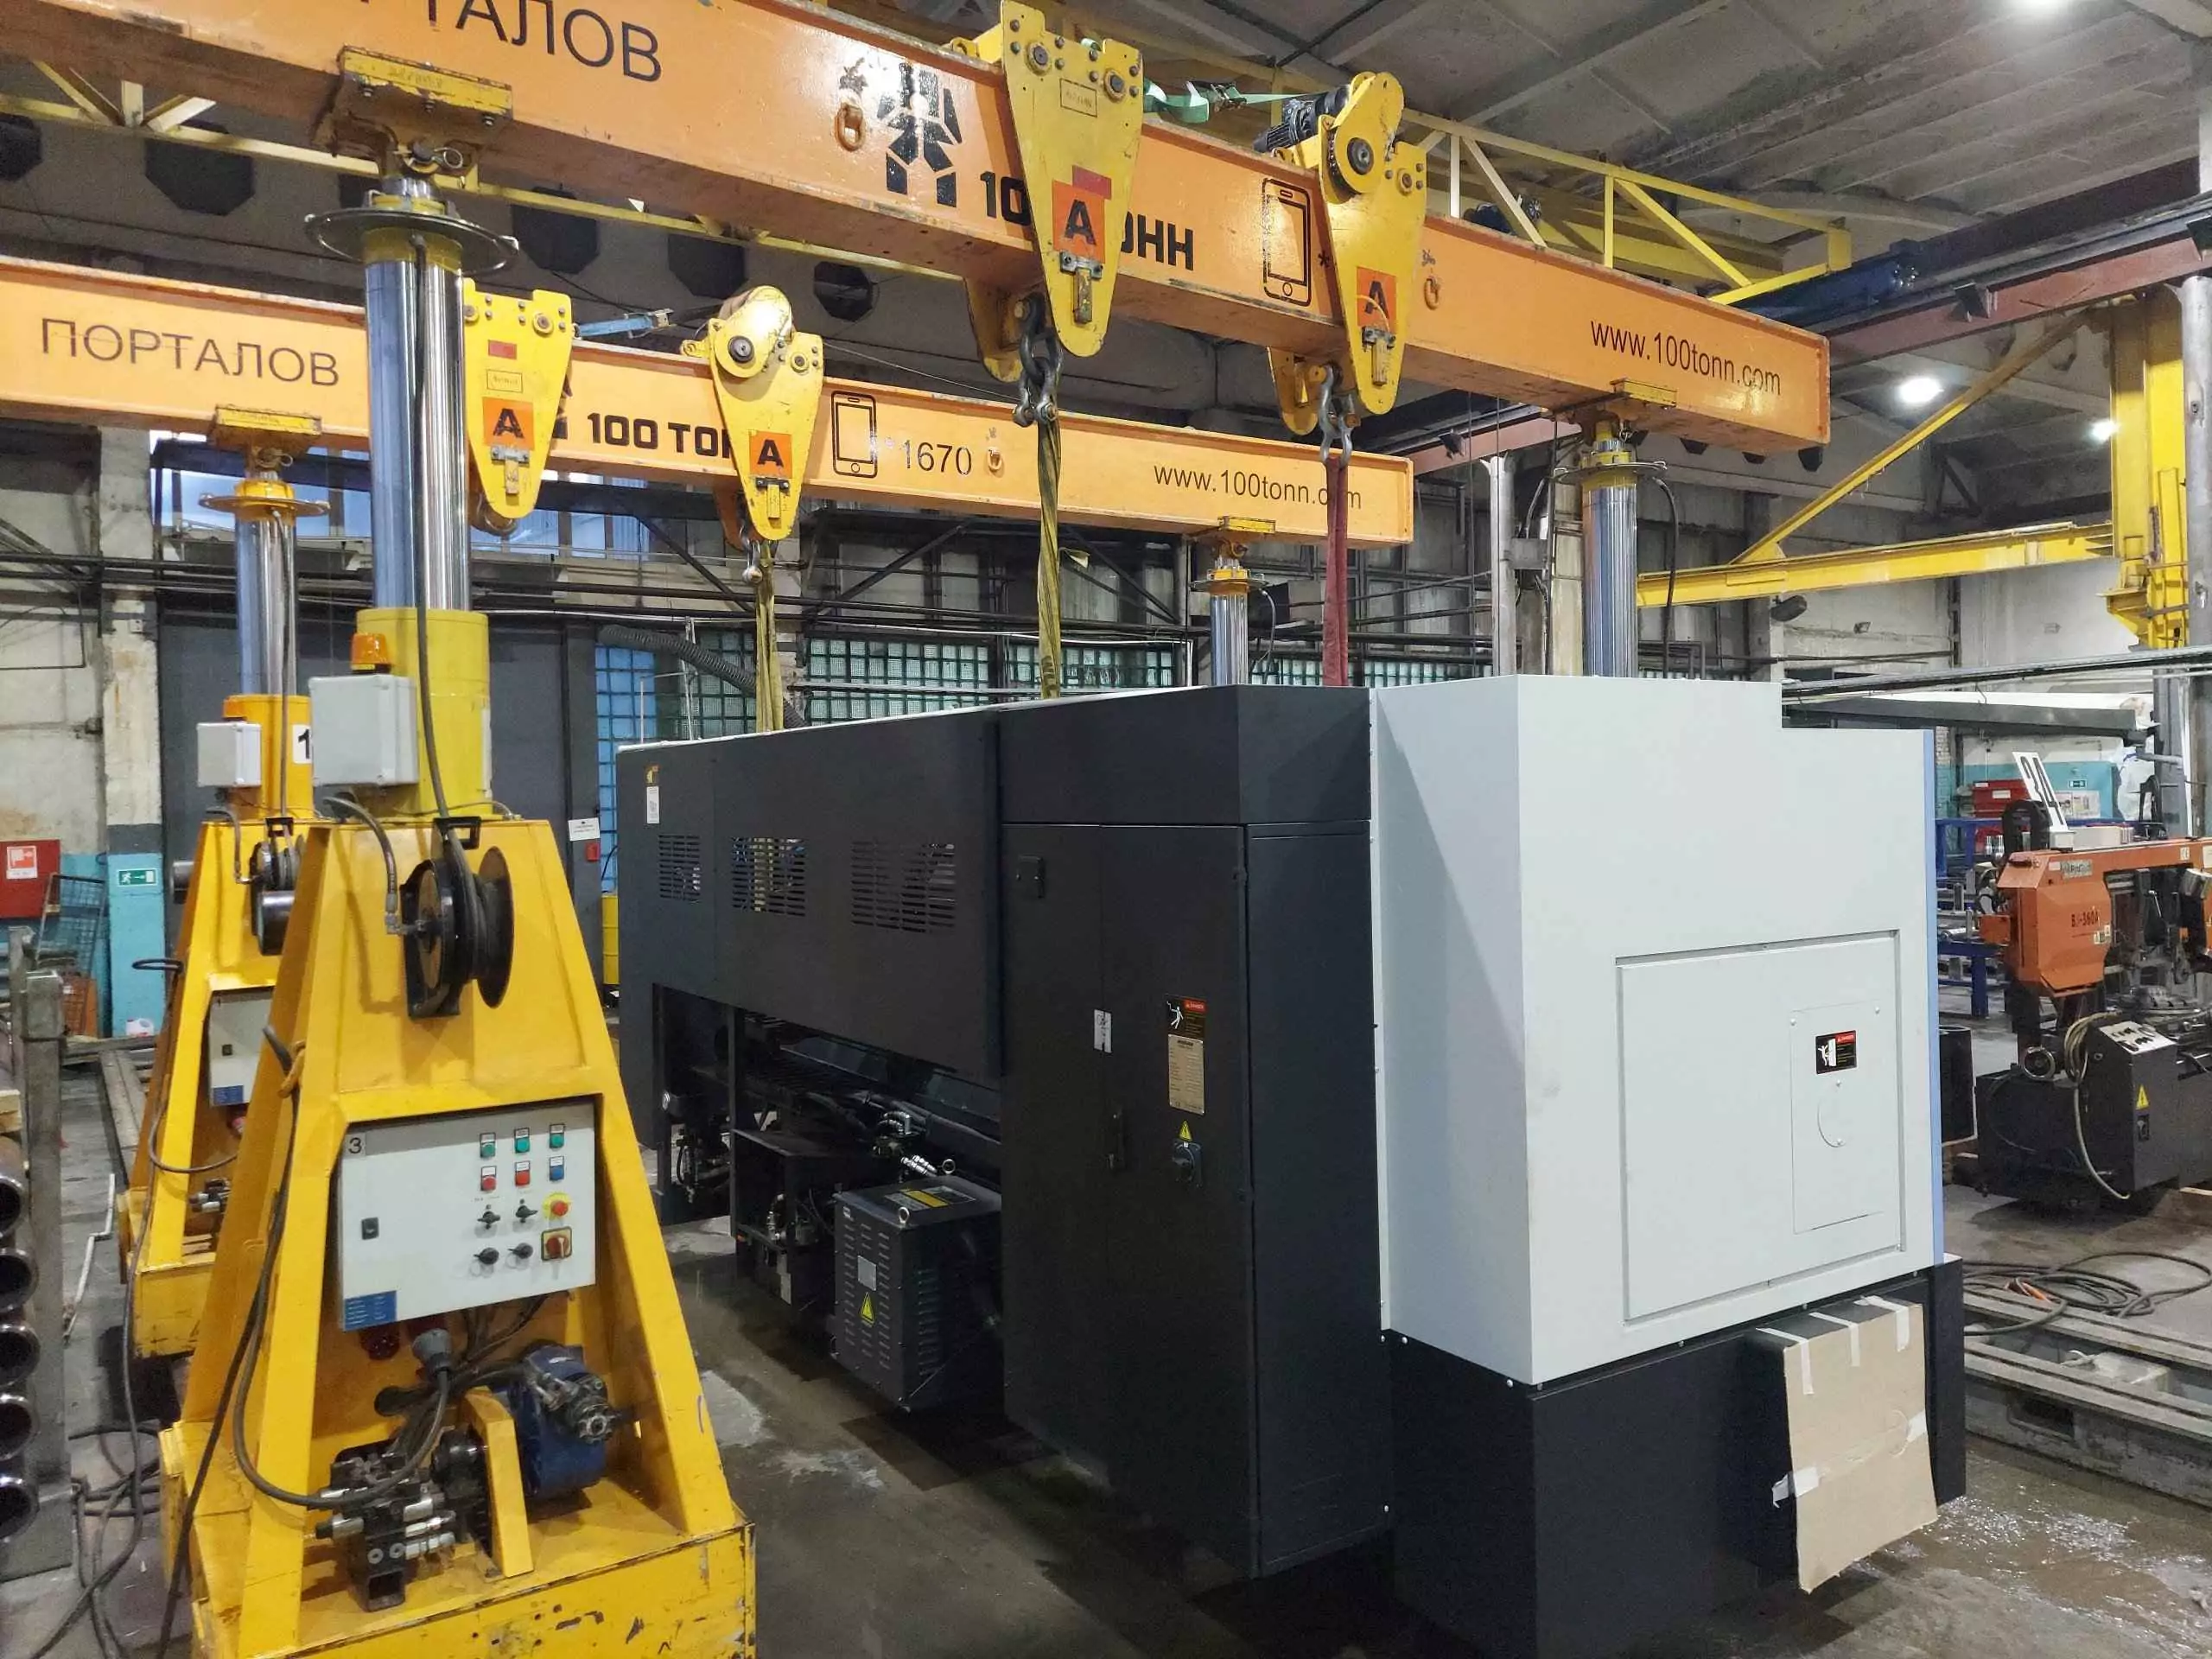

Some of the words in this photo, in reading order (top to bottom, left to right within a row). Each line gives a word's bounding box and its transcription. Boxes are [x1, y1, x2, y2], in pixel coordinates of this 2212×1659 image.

[41, 317, 340, 387] ПОРТАЛОВ
[1590, 321, 1782, 396] www.100tonn.com
[587, 411, 659, 451] 100
[899, 439, 973, 476] 1670
[1154, 465, 1362, 509] www.100tonn.cm
[347, 1137, 363, 1154] 3
